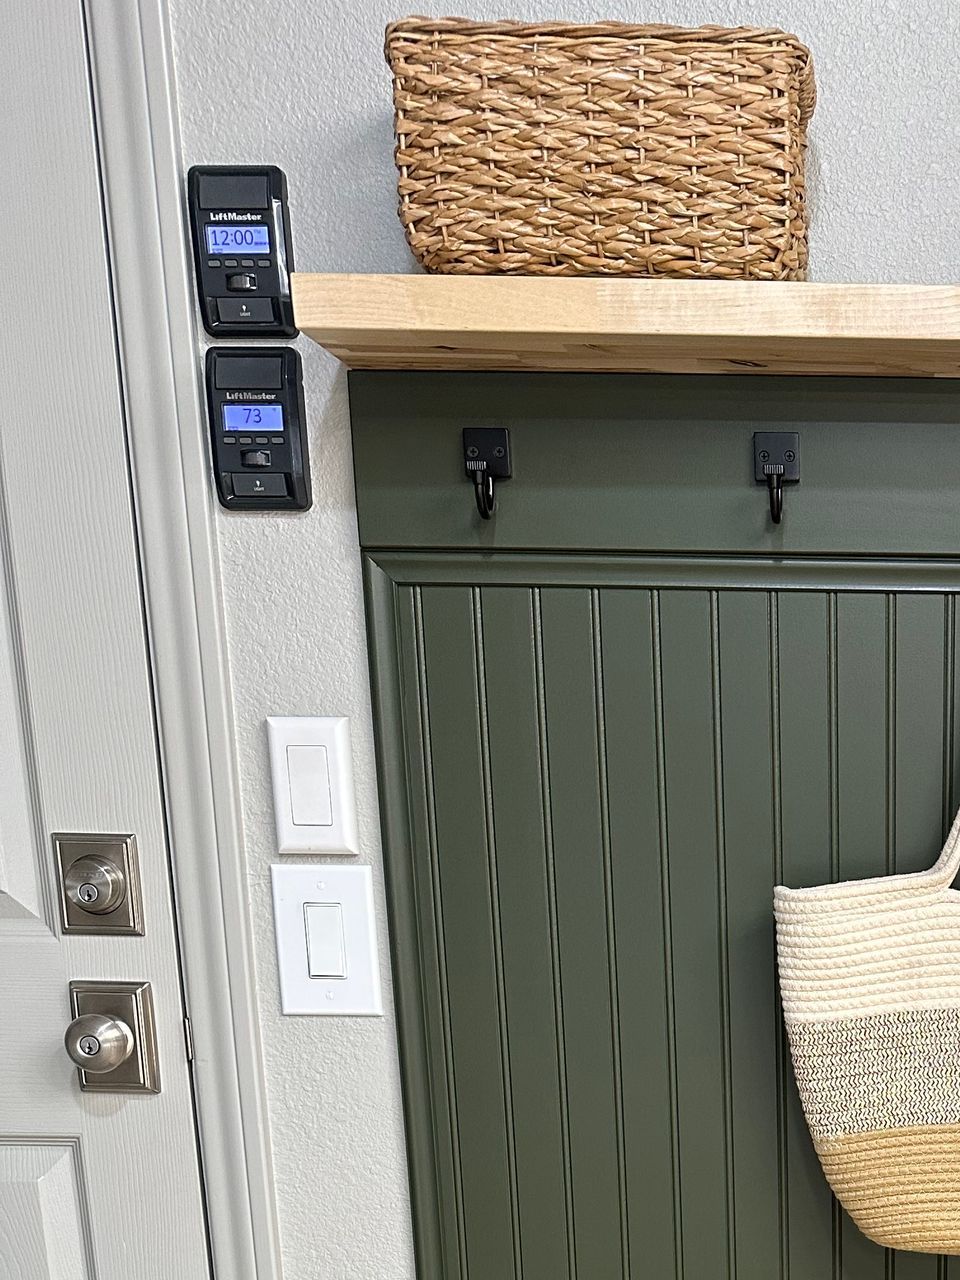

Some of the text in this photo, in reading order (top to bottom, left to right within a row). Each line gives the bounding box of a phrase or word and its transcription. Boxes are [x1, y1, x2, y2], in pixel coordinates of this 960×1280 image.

[210, 212, 262, 221] LiftMaster
[211, 229, 254, 246] 12:00
[226, 391, 276, 400] LiftMaster
[242, 408, 262, 424] 73
